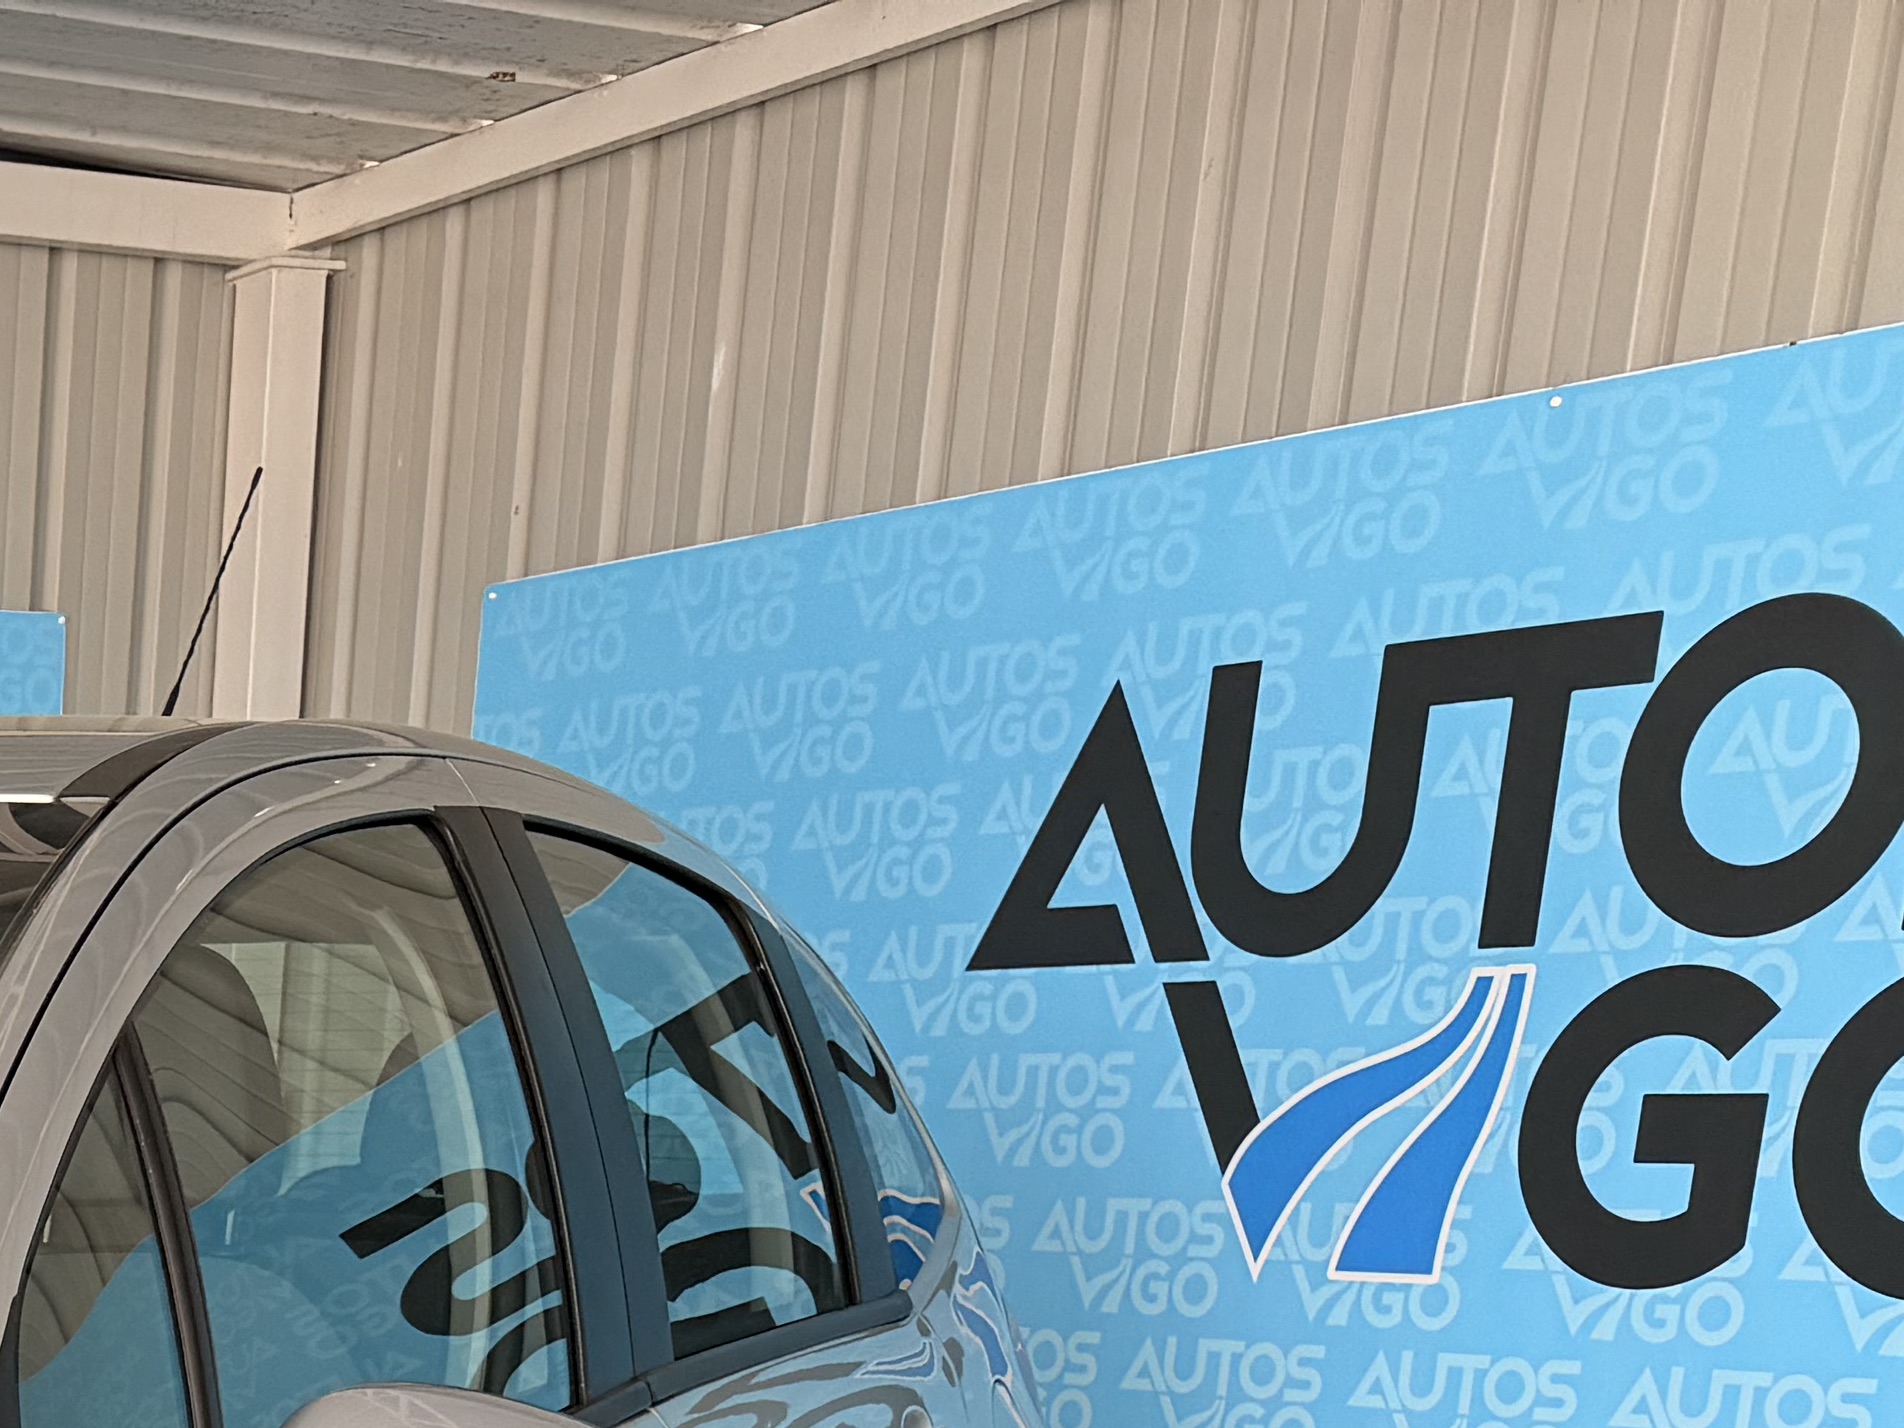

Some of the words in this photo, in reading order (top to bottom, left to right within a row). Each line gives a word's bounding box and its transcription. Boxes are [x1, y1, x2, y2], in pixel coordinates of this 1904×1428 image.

[1475, 367, 1734, 477] AUTOS
[1231, 415, 1453, 515] AUTOS
[821, 502, 992, 583] AUTOS
[1013, 462, 1210, 552] AUTOS
[495, 570, 634, 637] AUTOS
[648, 541, 798, 613] AUTOS
[720, 661, 881, 734] AUTOS
[899, 633, 1082, 712] AUTOS
[558, 686, 701, 752] AUTOS
[790, 781, 961, 851] AUTOS
[946, 1053, 1134, 1110] AUTOS
[1031, 1196, 1226, 1259] AUTOS
[1118, 1335, 1328, 1404] AUTOS
[1346, 1348, 1583, 1424] AUTOS
